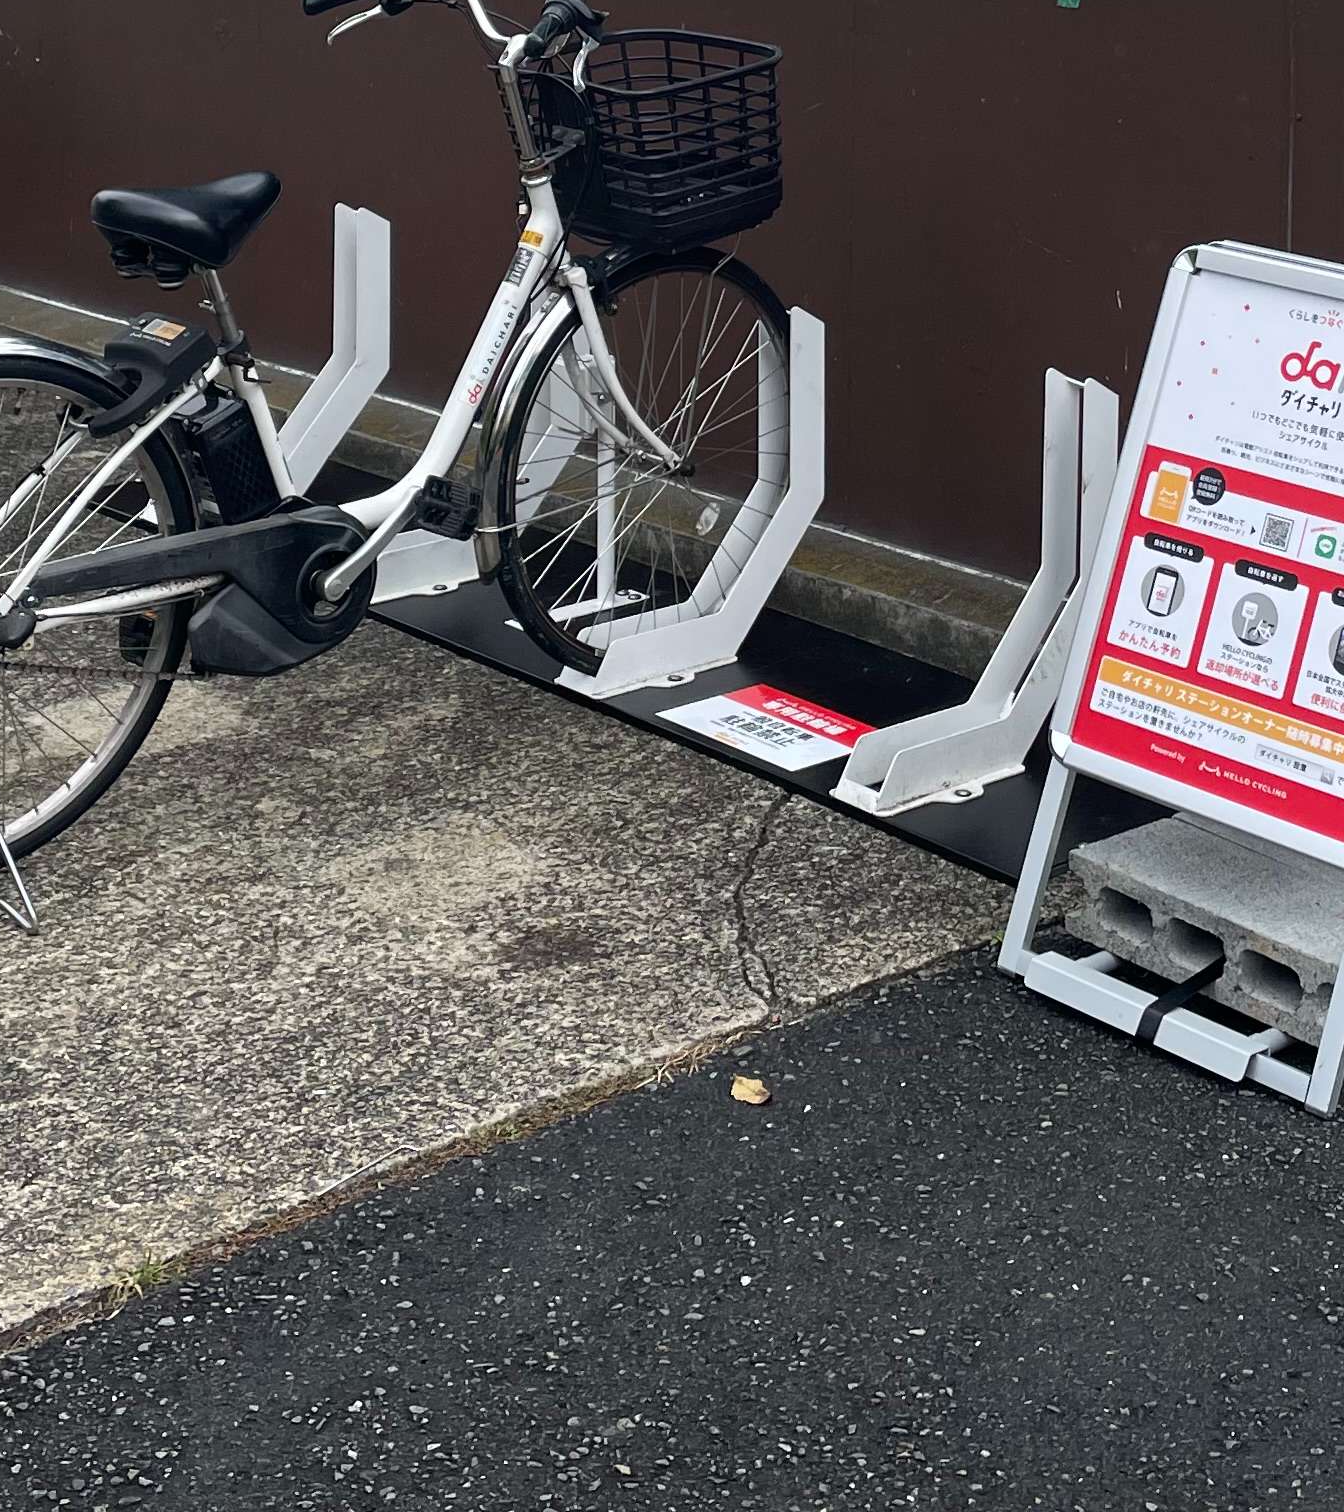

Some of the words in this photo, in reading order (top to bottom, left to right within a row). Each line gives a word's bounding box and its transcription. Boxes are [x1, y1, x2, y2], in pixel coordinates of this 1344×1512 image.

[482, 304, 518, 375] DAICHARI
[1280, 388, 1342, 419] ダイチャリ
[1278, 430, 1329, 452] シェアサイクル
[1127, 619, 1178, 642] アプリで自転車を
[1118, 630, 1182, 660] かんたん予約
[1205, 659, 1280, 692] 返却場所が選べる
[1220, 652, 1269, 673] ステーションなら
[1121, 670, 1175, 697] ダイチャリ
[1150, 743, 1176, 760] Powered
[1175, 750, 1187, 764] by
[1259, 749, 1292, 768] ダイチャリ
[1223, 770, 1251, 786] HELLO
[1251, 780, 1288, 800] CYCLING
